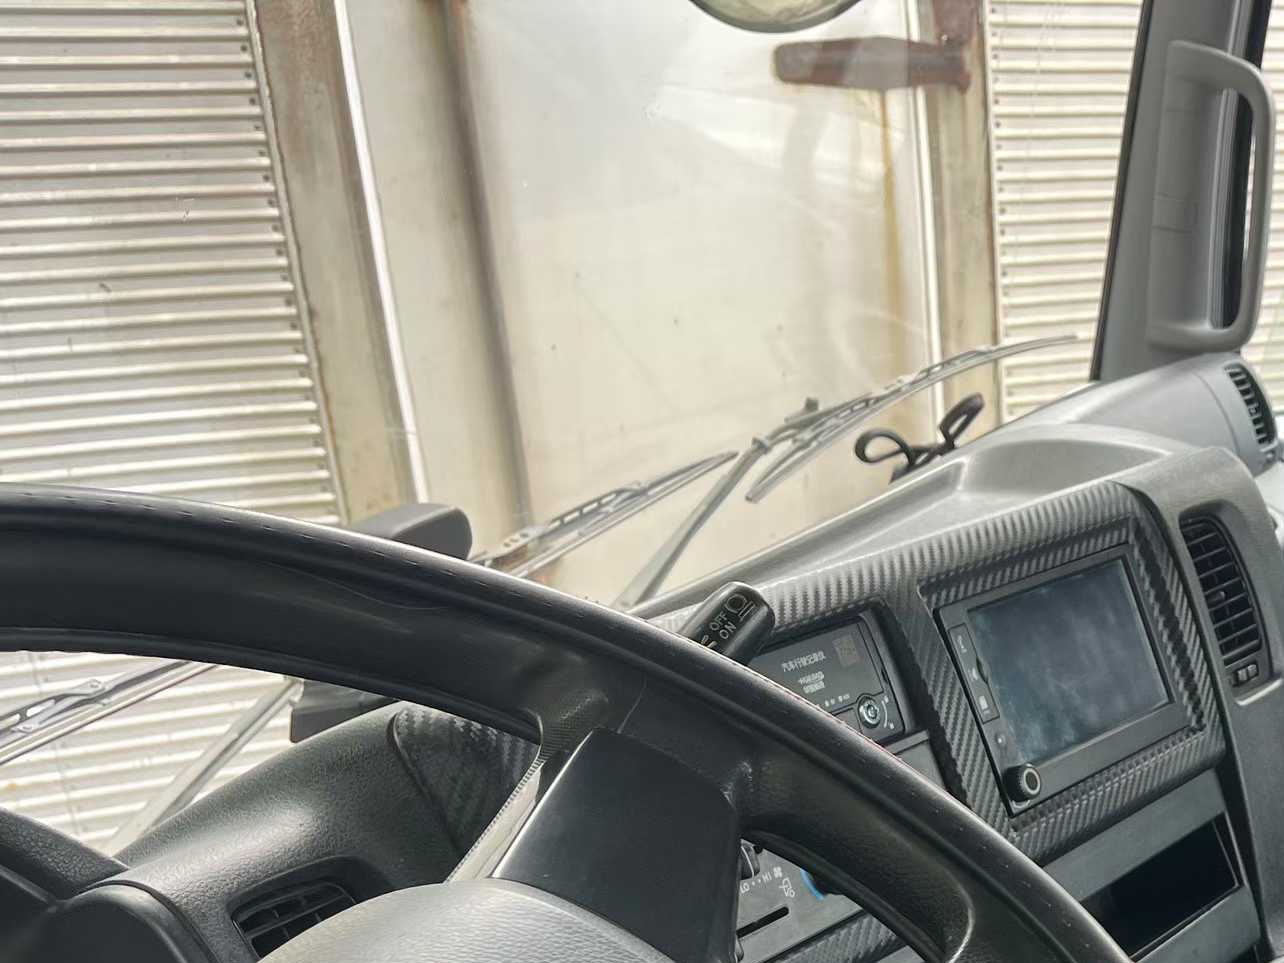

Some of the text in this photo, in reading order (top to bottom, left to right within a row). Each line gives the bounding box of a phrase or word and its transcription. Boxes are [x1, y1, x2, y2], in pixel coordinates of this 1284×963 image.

[710, 611, 727, 631] OFF
[720, 621, 736, 639] ON
[740, 872, 772, 893] LO HI
